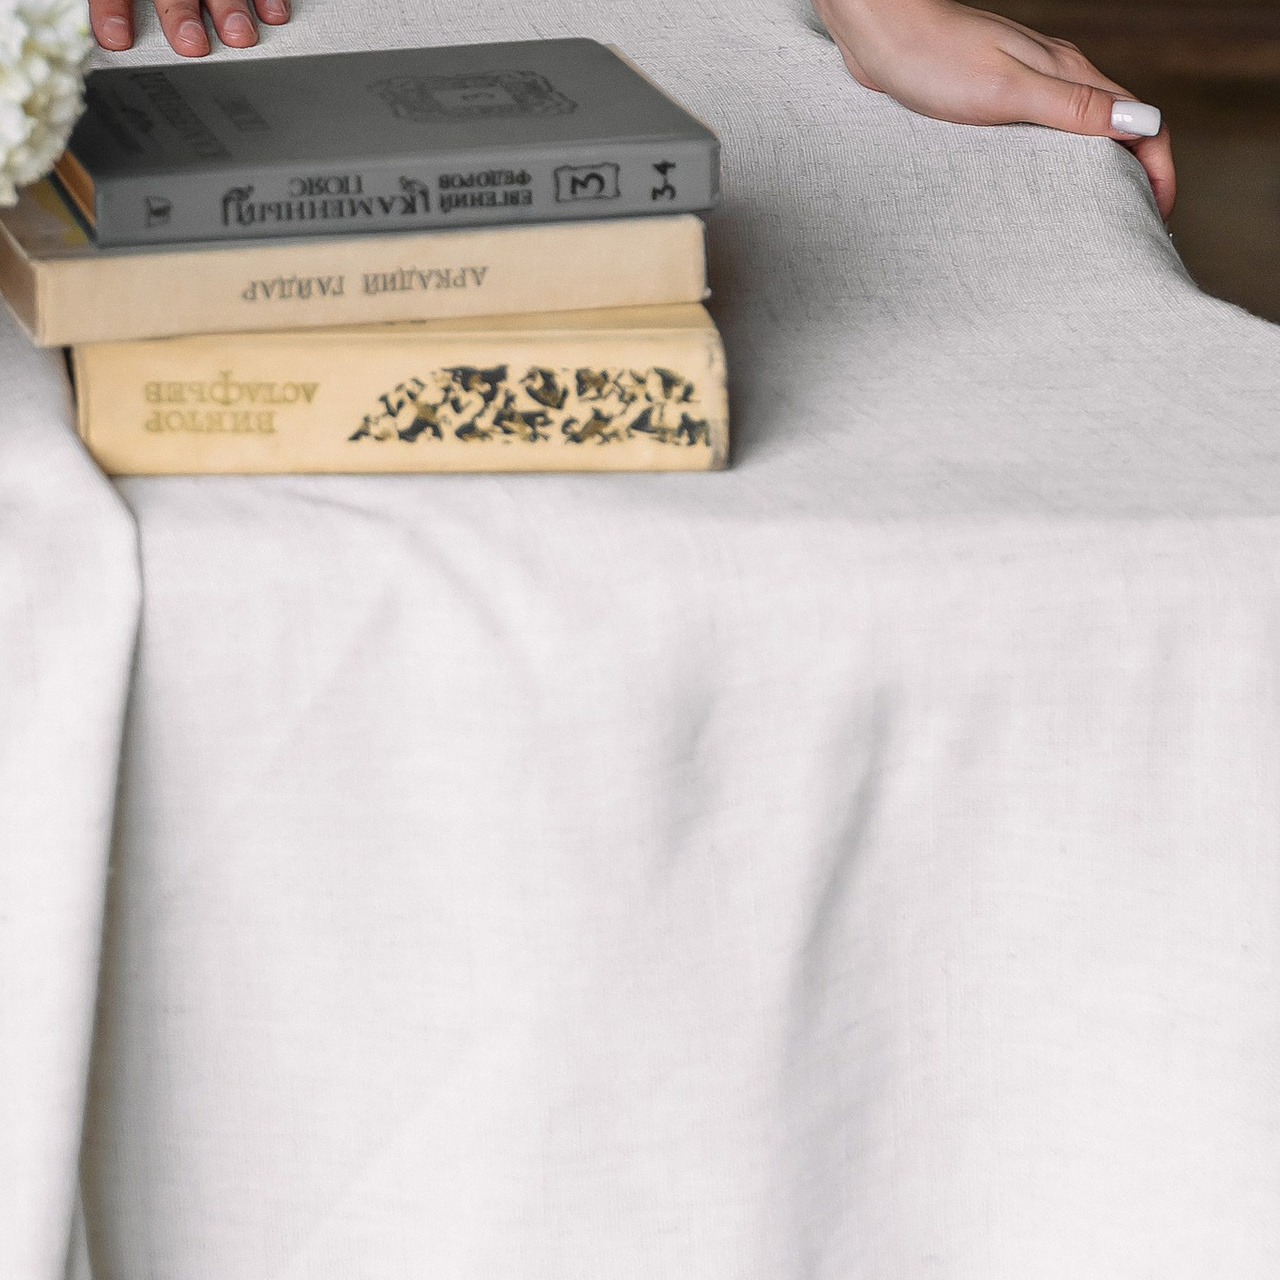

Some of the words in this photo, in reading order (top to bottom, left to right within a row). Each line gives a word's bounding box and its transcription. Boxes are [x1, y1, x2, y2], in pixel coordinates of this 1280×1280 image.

[288, 175, 363, 197] ПОЯС
[438, 170, 533, 190] ФЕДОРОВ
[571, 172, 605, 195] 3
[236, 194, 419, 226] КАМЕННЫЙ
[439, 188, 533, 213] ЕВГЕНИЙ
[240, 272, 344, 302] ГАЙДАР
[363, 265, 489, 296] АРКАДИЙ
[144, 370, 320, 406] АСТАФЬЕВ
[143, 411, 276, 434] ВИКТОР
